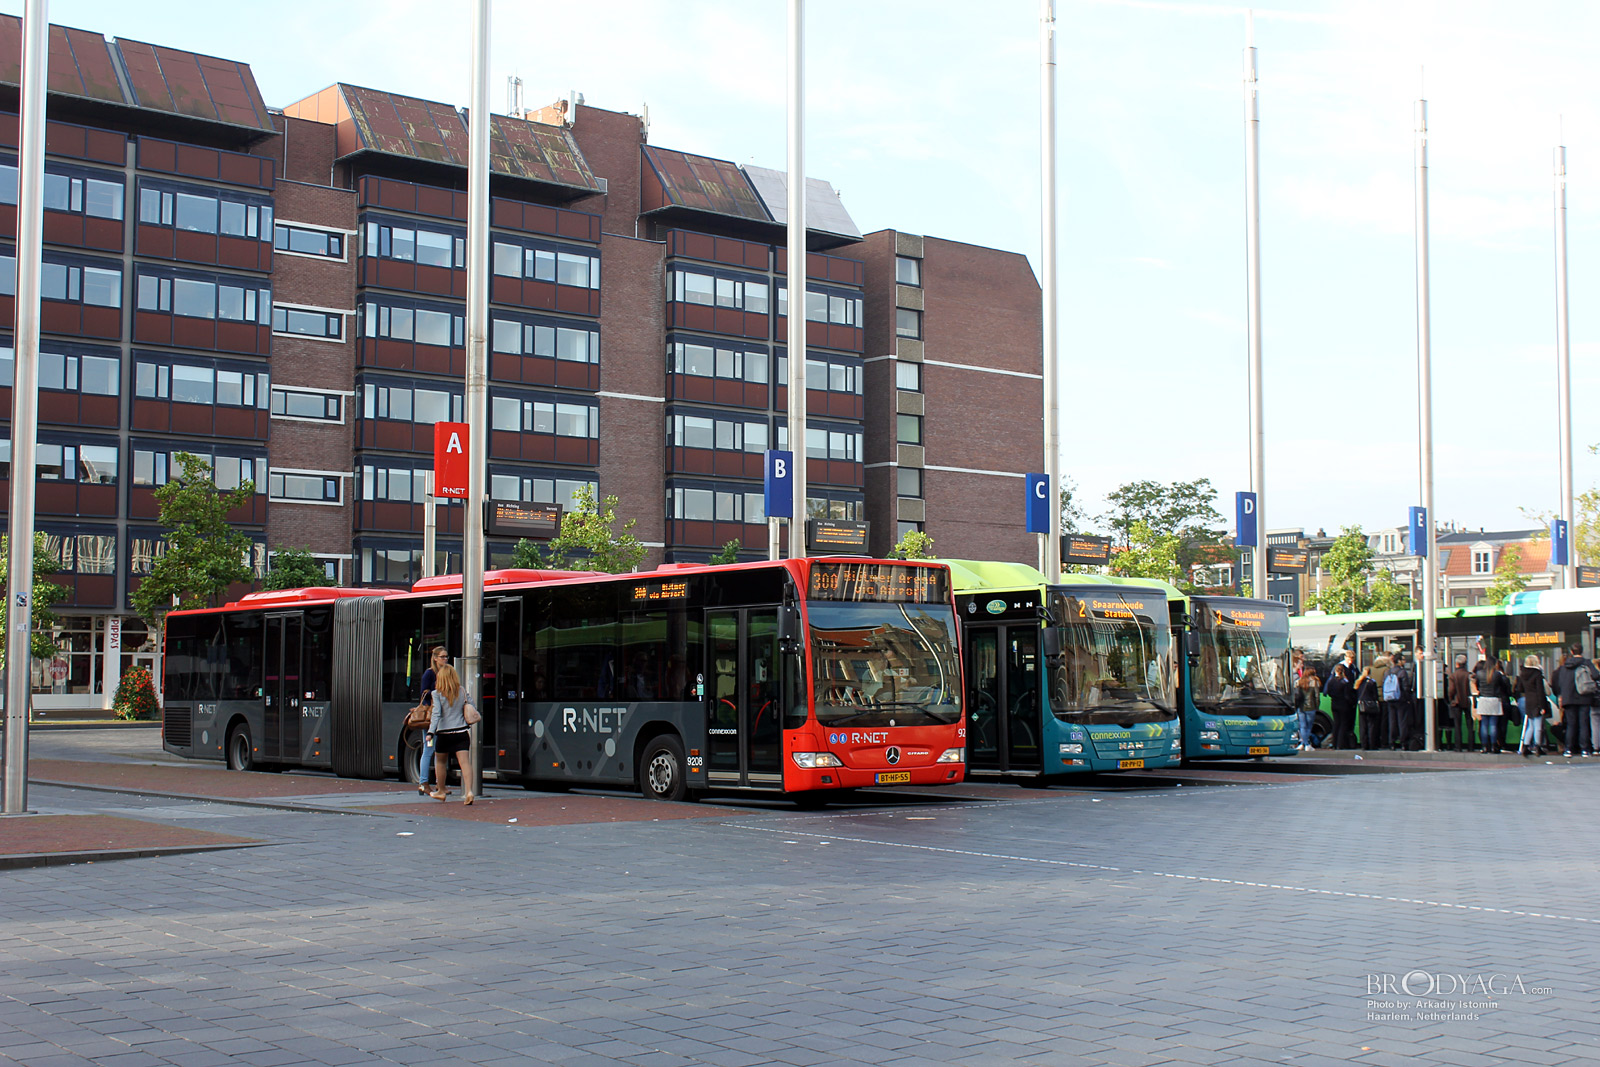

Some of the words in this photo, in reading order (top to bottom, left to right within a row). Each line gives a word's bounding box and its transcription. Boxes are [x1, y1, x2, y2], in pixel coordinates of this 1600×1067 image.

[446, 432, 463, 454] A
[775, 459, 786, 478] B
[1035, 481, 1046, 499] C
[1244, 499, 1254, 514] D
[1417, 512, 1423, 527] E
[1558, 524, 1565, 539] F
[813, 572, 838, 591] 300
[1078, 599, 1086, 618] 2
[1104, 609, 1133, 618] Station
[1215, 609, 1222, 625] 3
[1230, 610, 1265, 620] Schalkwijk
[1234, 618, 1261, 627] Centrum
[110, 618, 120, 649] PIPPA'S
[1090, 731, 1131, 740] connexxion
[686, 756, 703, 767] 9208
